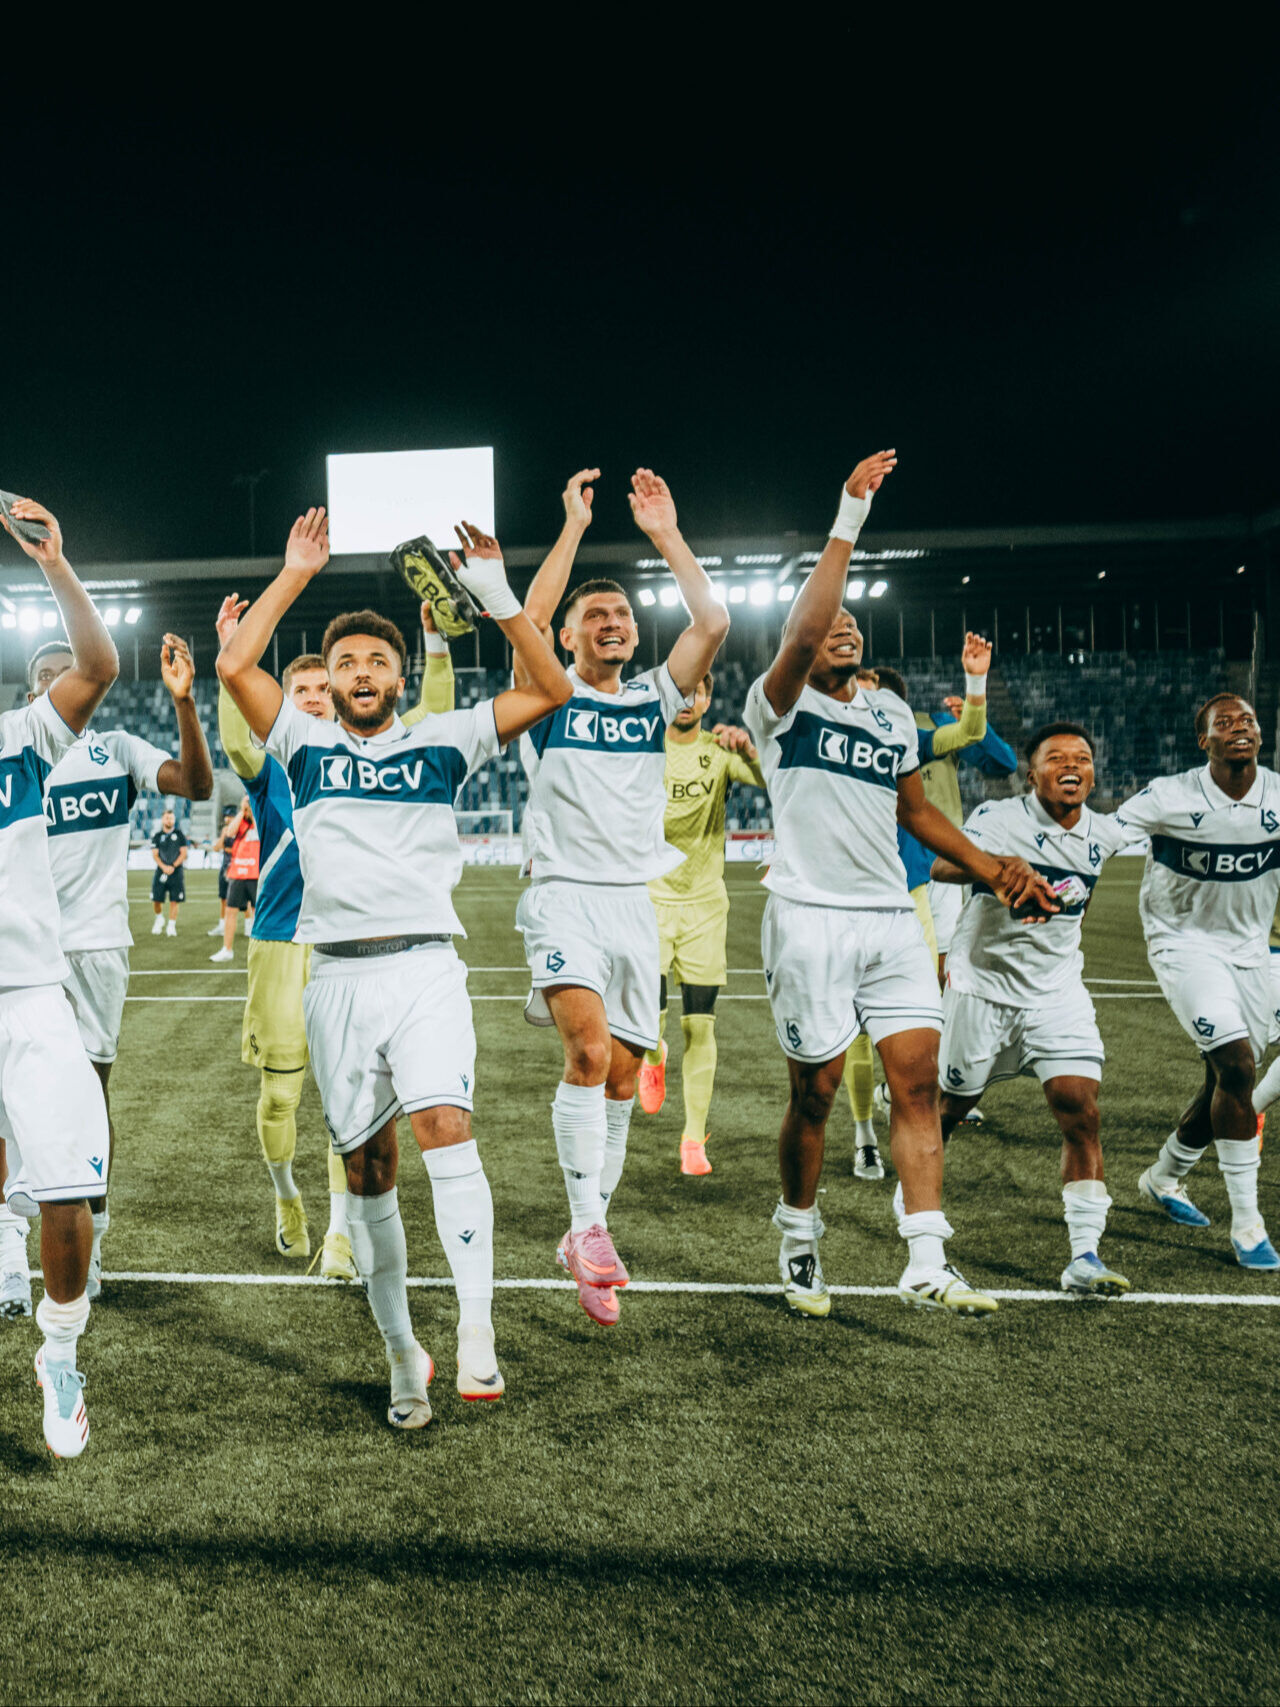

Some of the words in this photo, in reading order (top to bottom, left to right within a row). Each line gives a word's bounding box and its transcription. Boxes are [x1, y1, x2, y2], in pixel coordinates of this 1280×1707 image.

[601, 716, 660, 743] BCV
[357, 760, 424, 791] BCV
[672, 779, 715, 799] BCV
[60, 789, 119, 821] BCV
[1215, 848, 1273, 874] BCV
